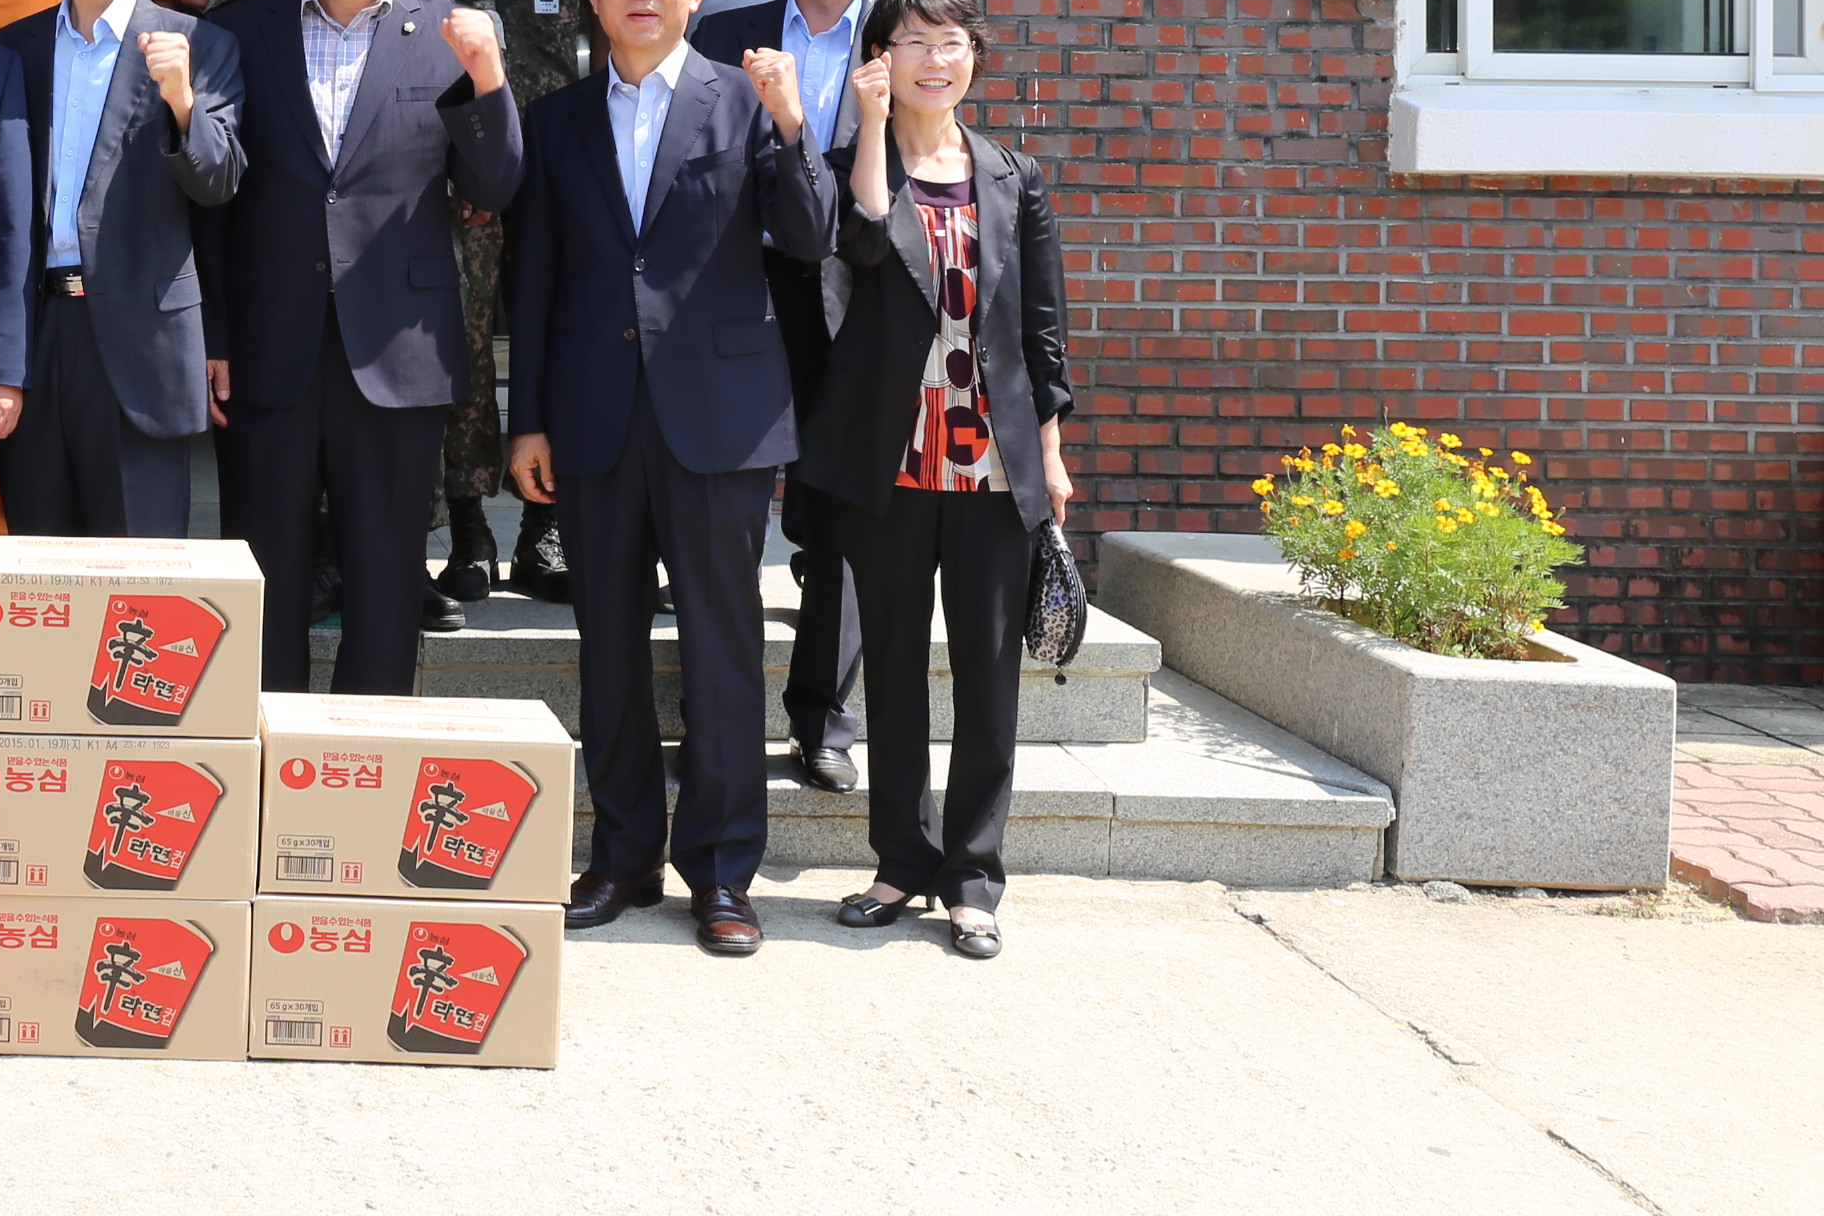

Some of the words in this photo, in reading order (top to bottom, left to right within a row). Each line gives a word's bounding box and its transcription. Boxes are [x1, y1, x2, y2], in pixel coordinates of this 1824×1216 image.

[1, 574, 84, 587] 2015.01.19까지
[90, 575, 102, 587] K1
[108, 576, 120, 587] A4
[127, 576, 150, 586] 23:53
[8, 602, 70, 628] 농심
[108, 619, 158, 690] 辛
[87, 739, 99, 750] K1
[106, 740, 118, 751] A4
[123, 740, 146, 750] 23:47
[5, 767, 67, 793] 농심
[320, 763, 383, 789] 농심
[105, 784, 155, 855] 辛
[419, 781, 469, 852] 辛
[309, 927, 372, 953] 농심
[96, 942, 146, 1012] 辛
[409, 945, 459, 1016] 辛
